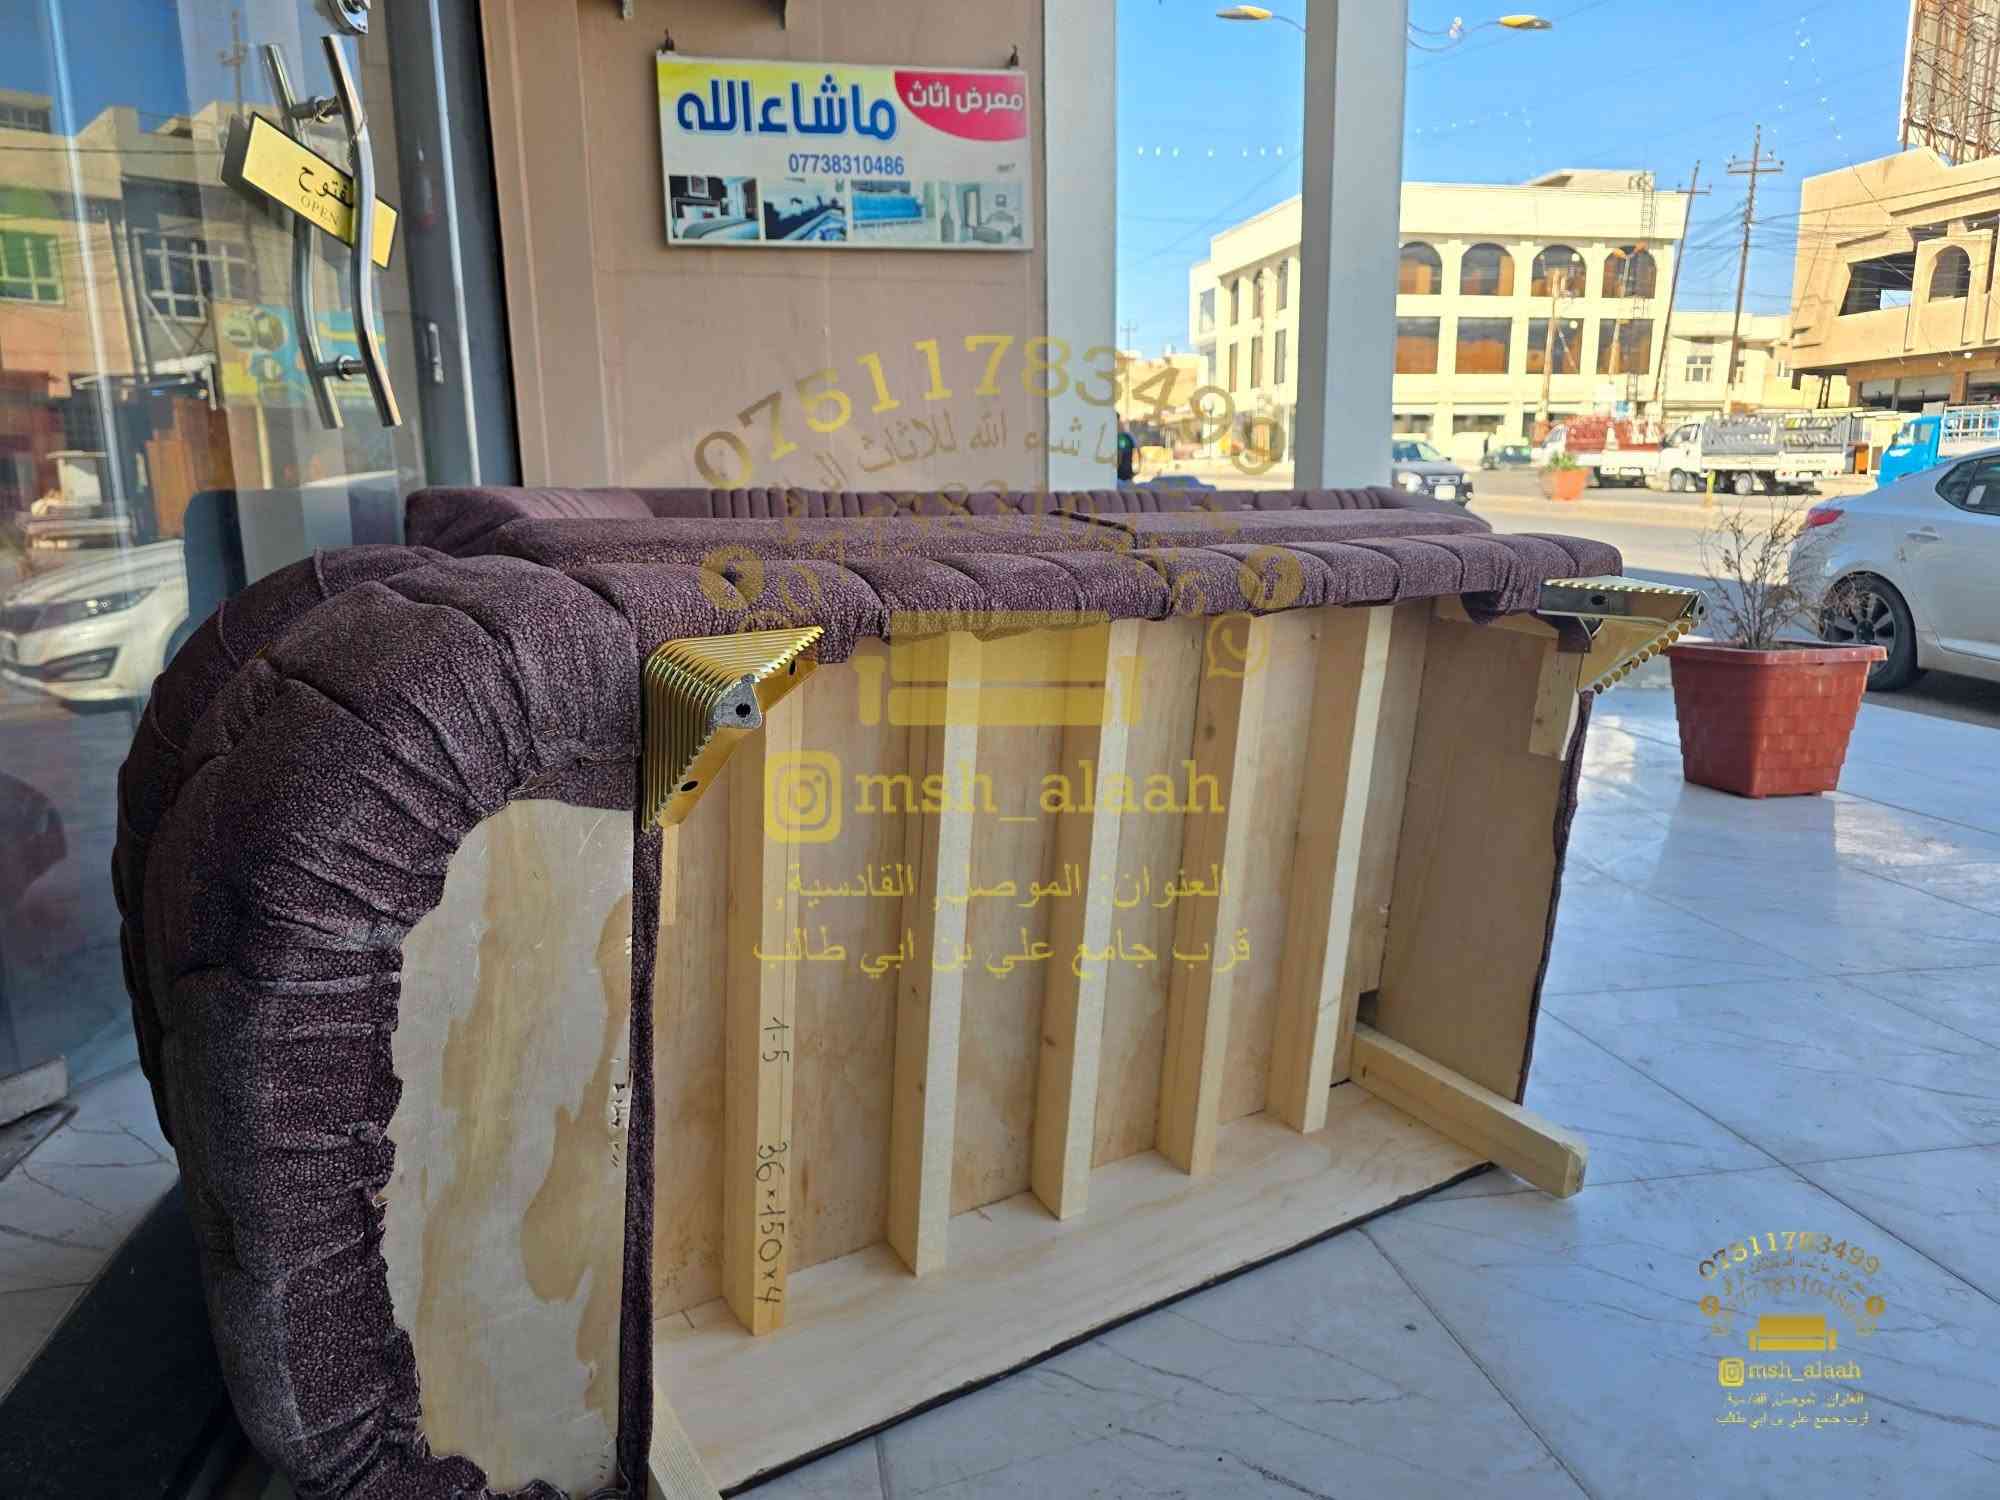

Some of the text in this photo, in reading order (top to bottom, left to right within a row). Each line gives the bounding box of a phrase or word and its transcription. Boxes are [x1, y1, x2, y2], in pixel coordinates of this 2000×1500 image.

[955, 86, 1024, 113] معرض
[788, 153, 905, 175] 07738310486
[298, 166, 354, 209] فتوح
[300, 195, 338, 225] OPEN
